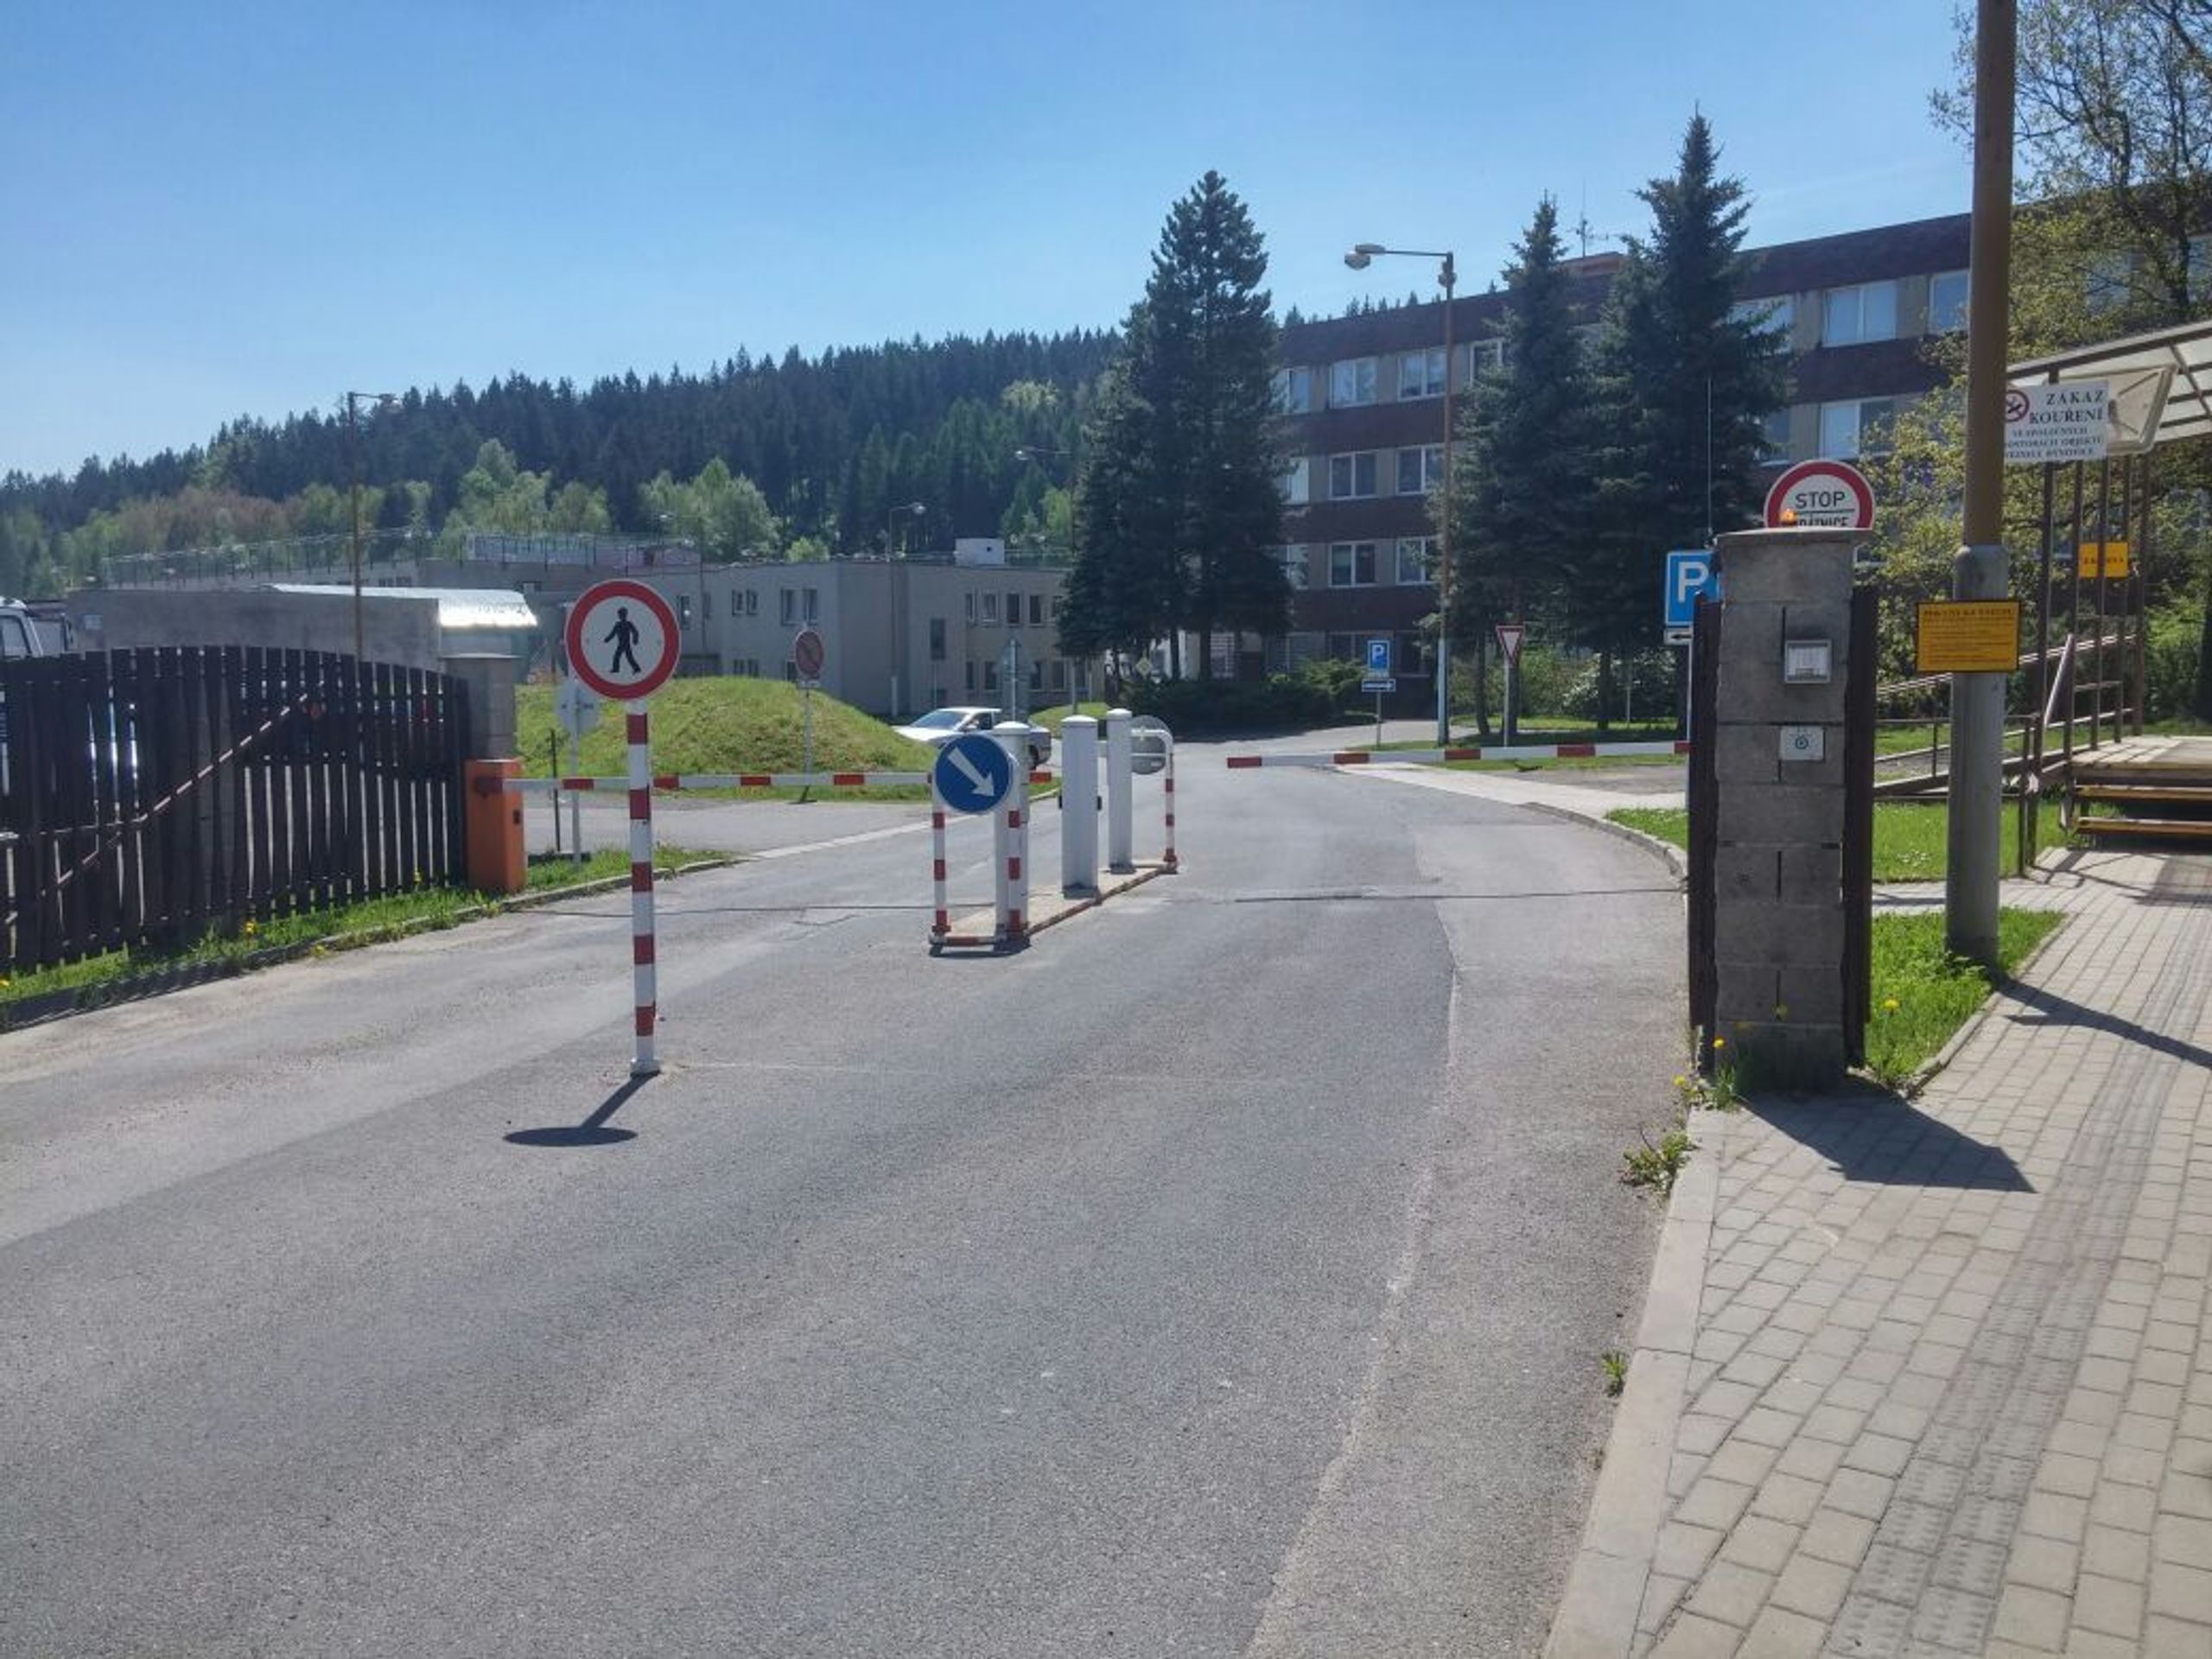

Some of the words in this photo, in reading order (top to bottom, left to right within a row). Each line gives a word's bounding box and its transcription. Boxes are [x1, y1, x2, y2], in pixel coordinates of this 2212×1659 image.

[1795, 491, 1846, 509] STOP
[1678, 562, 1709, 603] P
[1372, 645, 1384, 662] P
